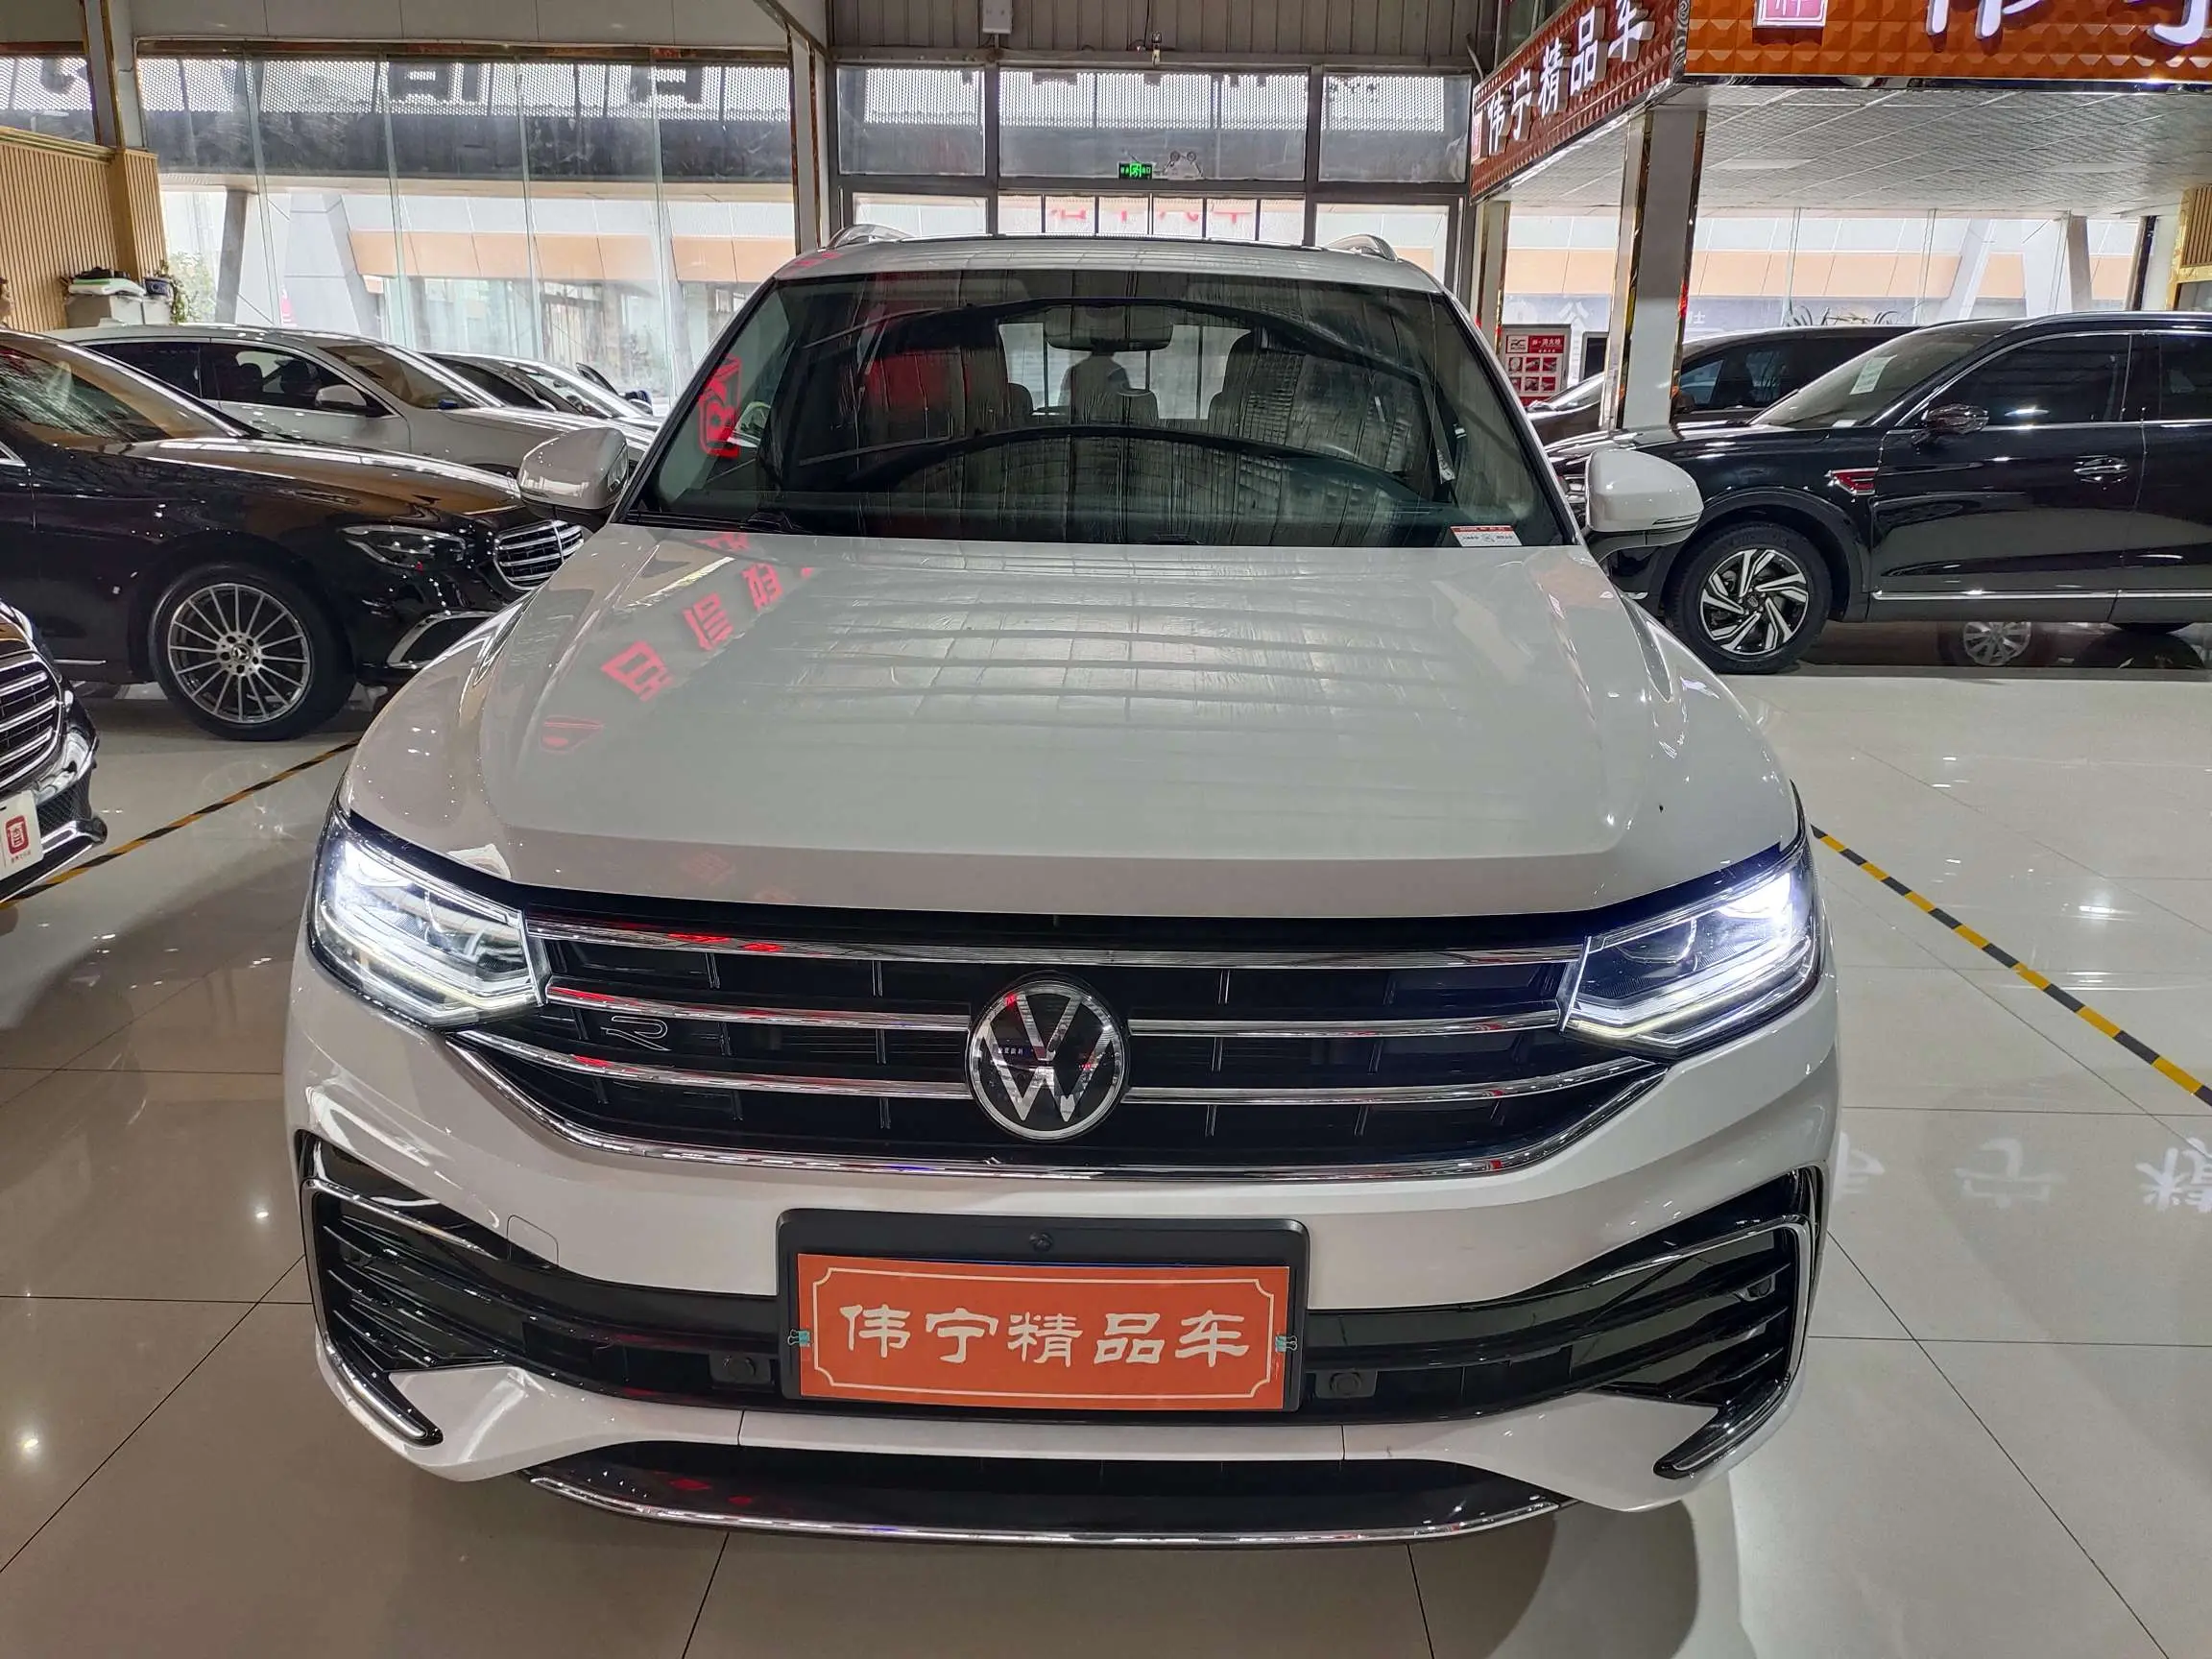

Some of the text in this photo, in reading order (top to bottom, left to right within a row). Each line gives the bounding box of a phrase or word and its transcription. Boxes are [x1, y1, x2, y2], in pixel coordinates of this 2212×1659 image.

[1487, 0, 1644, 155] 伟宁精品车
[600, 1015, 671, 1052] R
[838, 1303, 1250, 1368] 伟宁精品车
